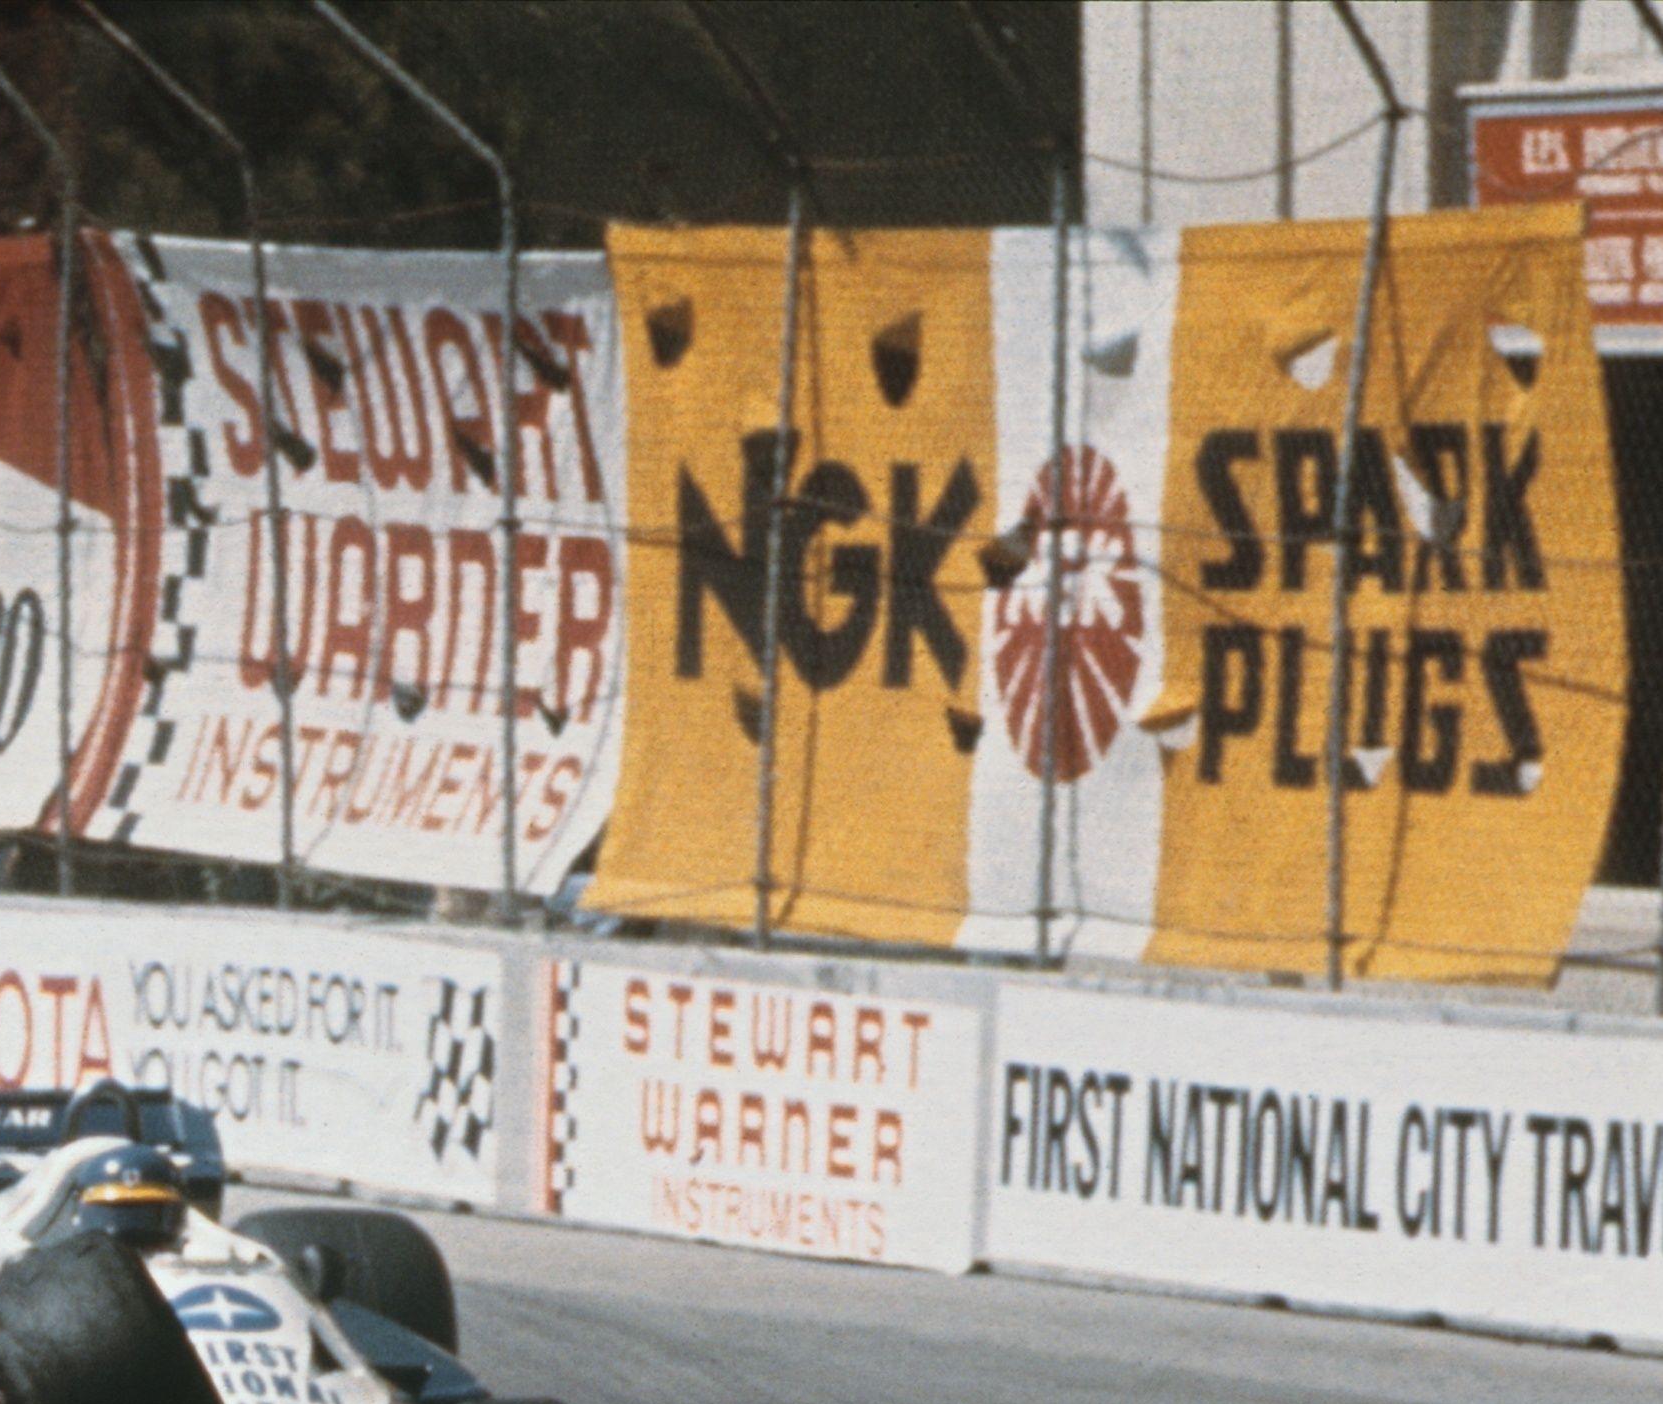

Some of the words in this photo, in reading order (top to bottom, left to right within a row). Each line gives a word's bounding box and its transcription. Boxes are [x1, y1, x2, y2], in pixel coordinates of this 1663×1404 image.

[199, 290, 606, 501] STEWART
[673, 426, 984, 692] NGK
[1195, 423, 1547, 593] SPARK
[240, 506, 614, 725] WARNER
[1199, 626, 1548, 799] PLUGS
[177, 714, 584, 841] INSTRUMENTS
[128, 960, 192, 1030] YOU
[198, 963, 300, 1035] ASKED
[305, 971, 366, 1046] FOR
[624, 978, 931, 1089] STEWART
[200, 1050, 266, 1122] GOT
[640, 1077, 904, 1188] WARNER
[652, 1177, 887, 1258] INSTRUMENTS
[1000, 1062, 1131, 1200] FIRST
[1144, 1075, 1380, 1232] NATIONAL
[1396, 1103, 1511, 1244] CITY
[1526, 1113, 1663, 1259] TRAV
[207, 1340, 298, 1372] IRST
